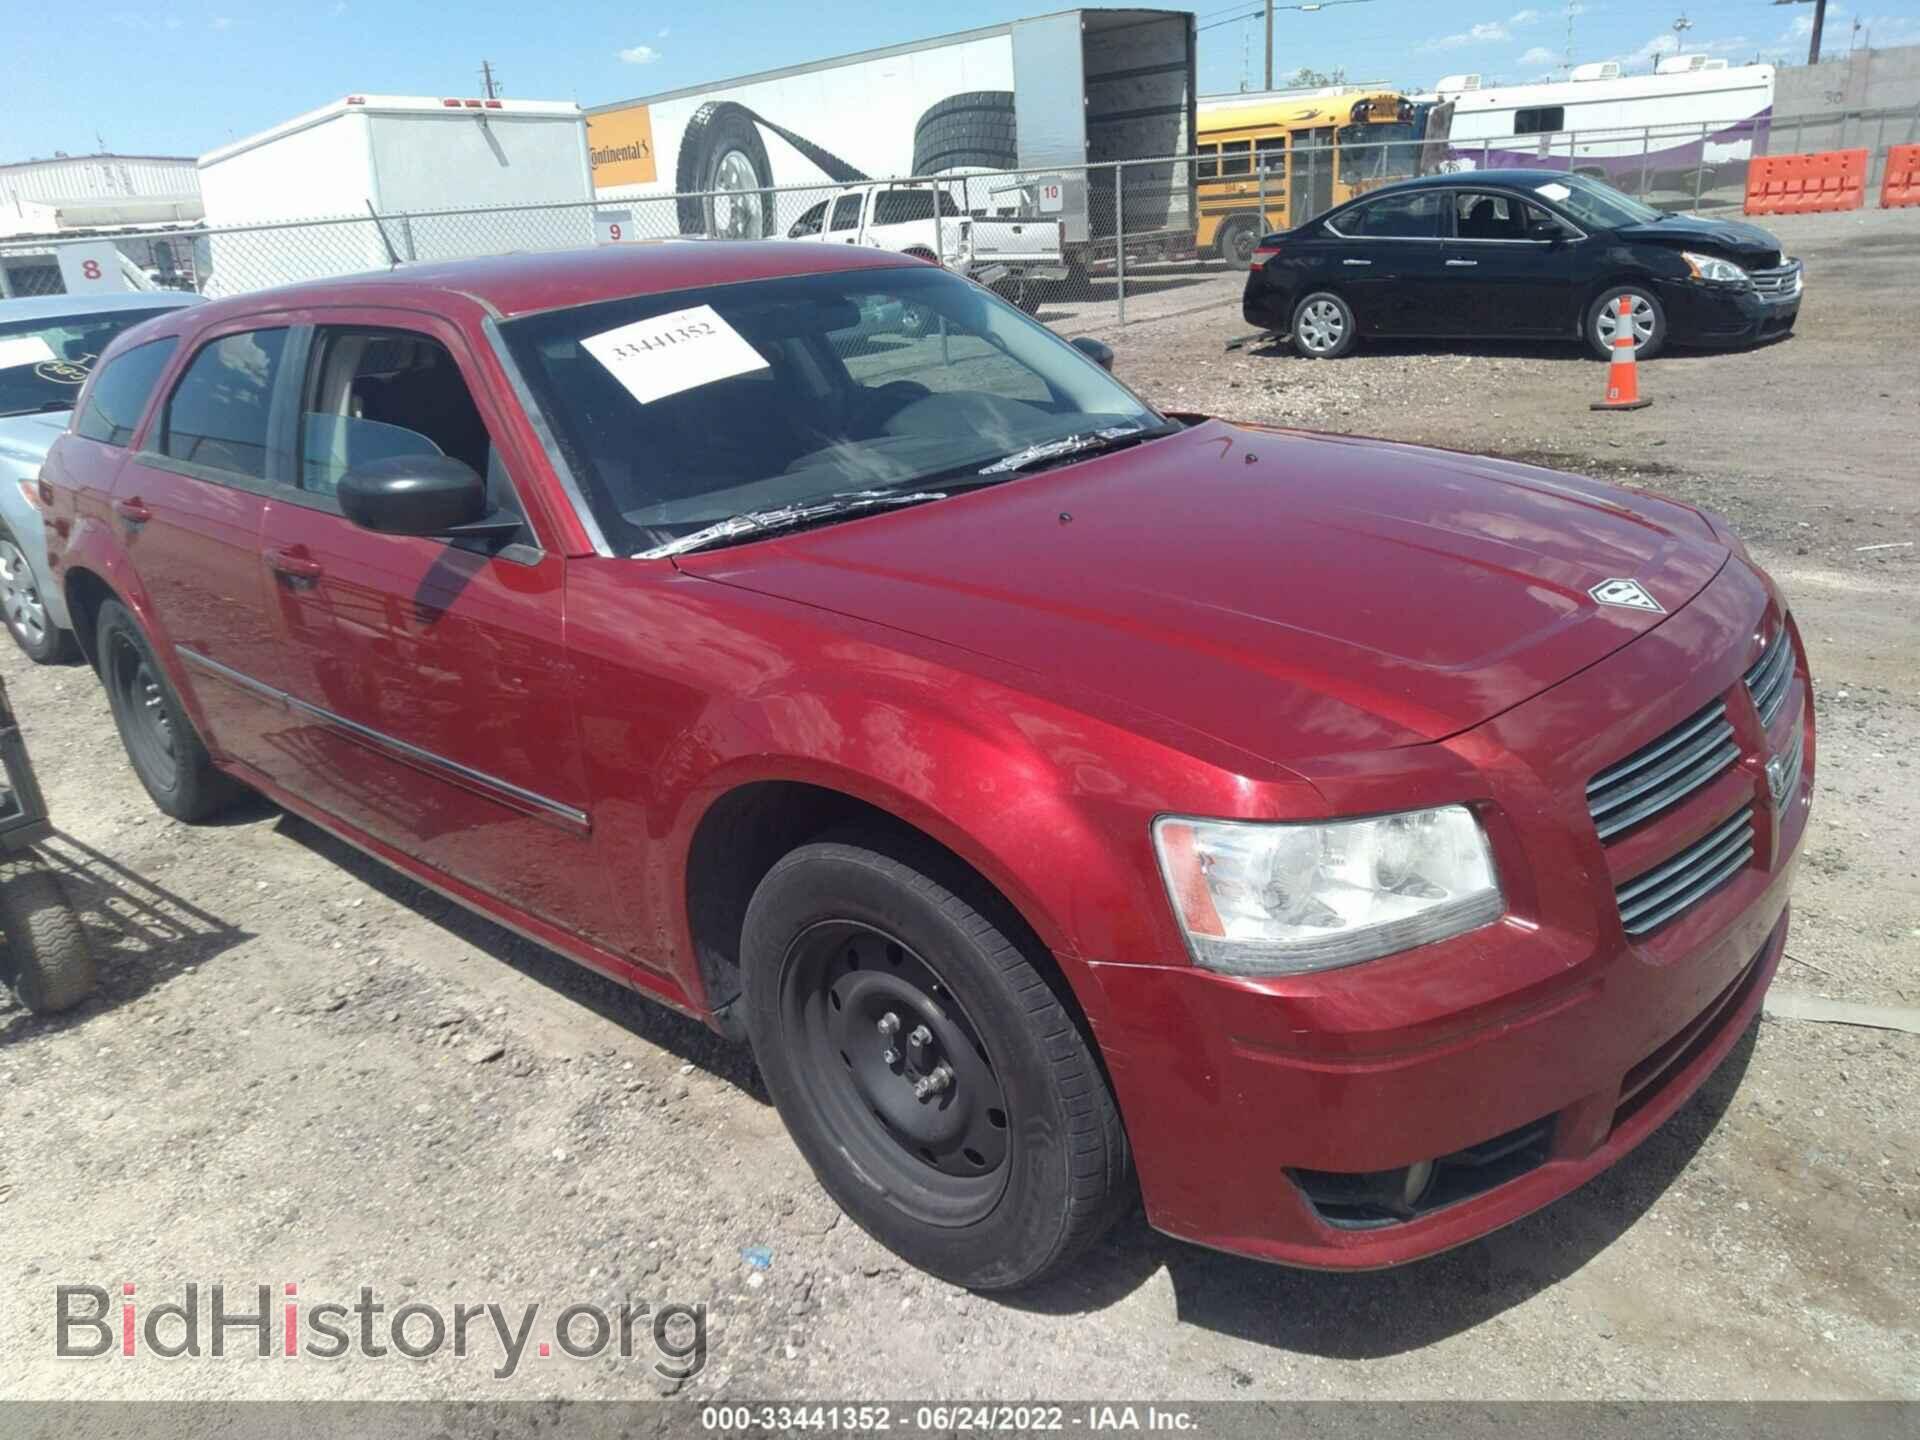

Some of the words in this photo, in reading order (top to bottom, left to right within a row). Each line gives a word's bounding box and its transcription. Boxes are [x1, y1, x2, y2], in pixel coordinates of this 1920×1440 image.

[1045, 185, 1058, 199] 10
[609, 223, 621, 240] 9
[82, 259, 102, 280] 8
[612, 322, 716, 361] 33441352
